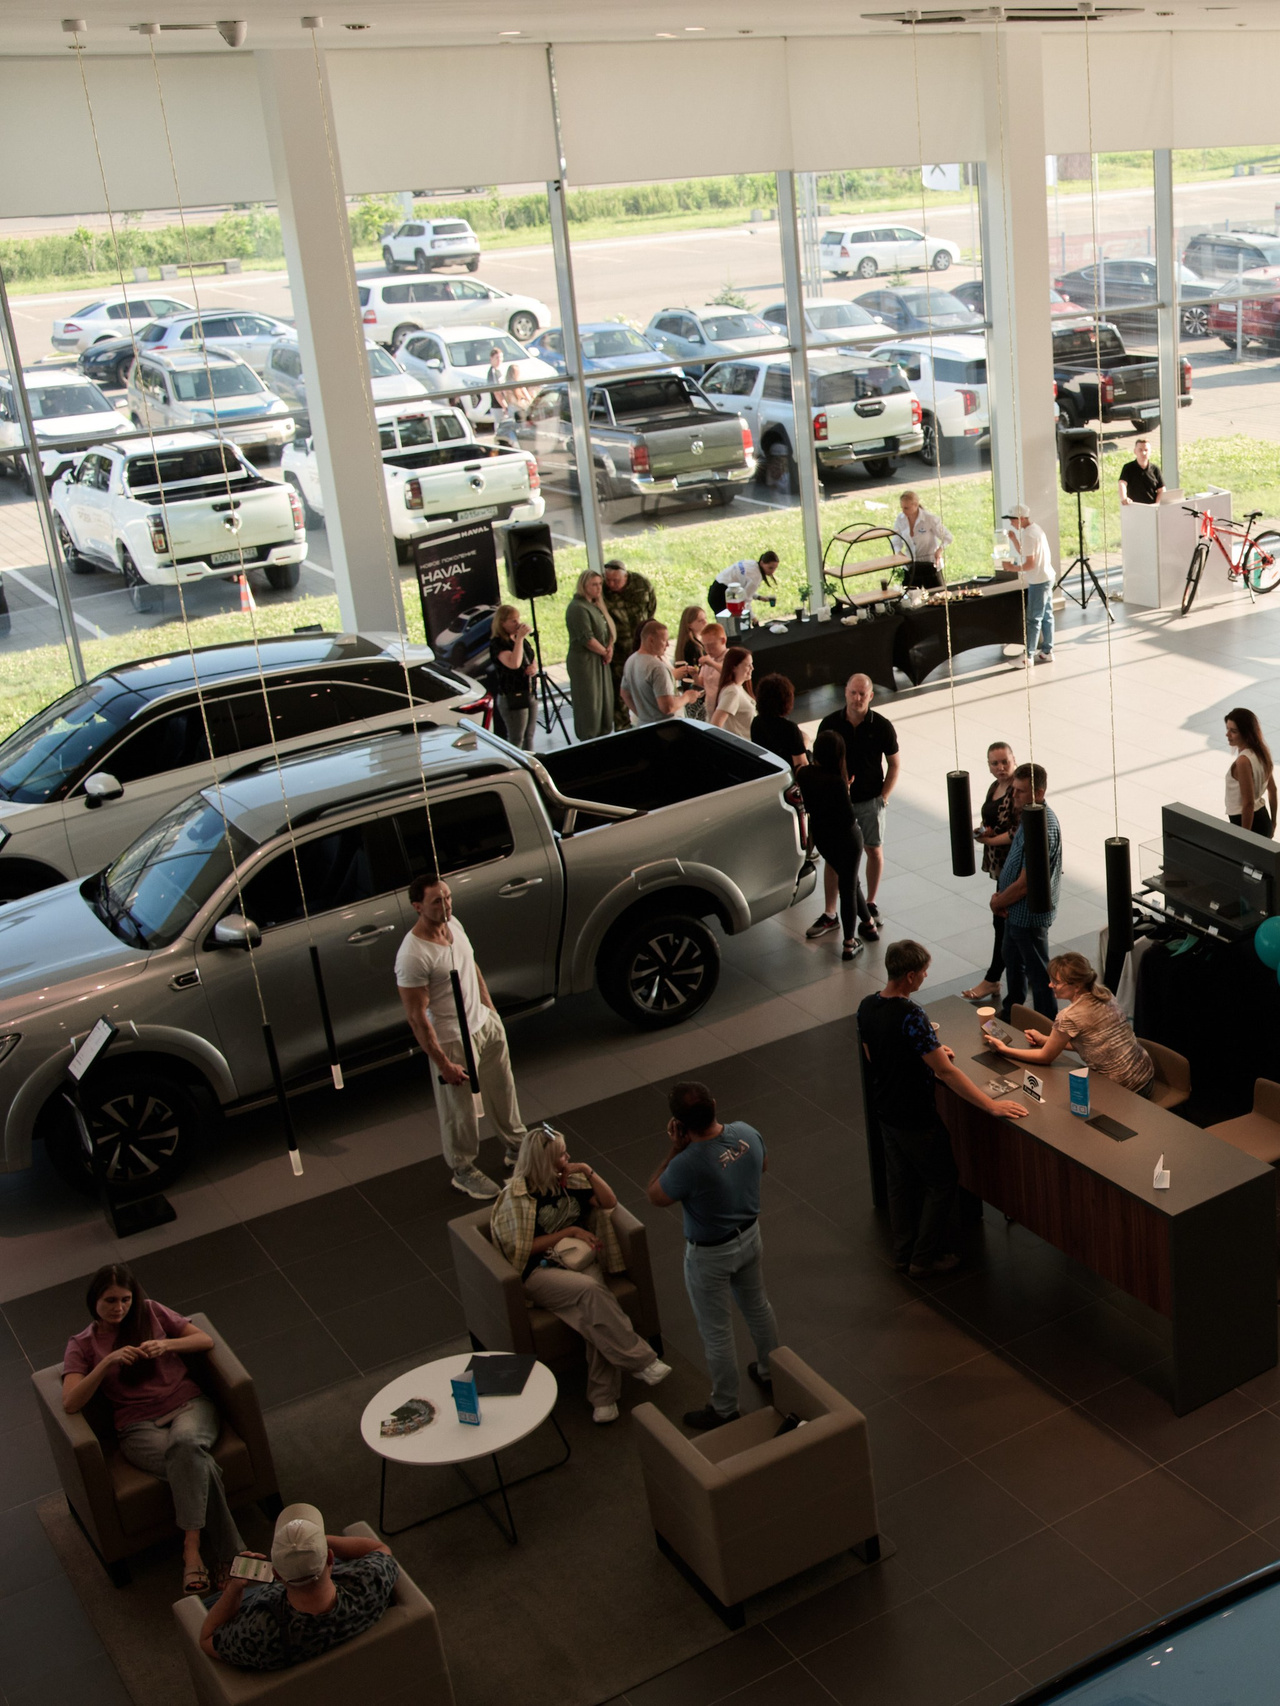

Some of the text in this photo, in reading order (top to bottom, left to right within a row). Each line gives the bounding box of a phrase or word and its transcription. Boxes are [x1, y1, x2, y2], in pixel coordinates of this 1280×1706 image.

[461, 526, 489, 538] HAVAL
[420, 549, 477, 570] НОВОЕ ПОКОЛЕНИЕ
[421, 562, 471, 585] HAVAL
[423, 582, 452, 597] F7x
